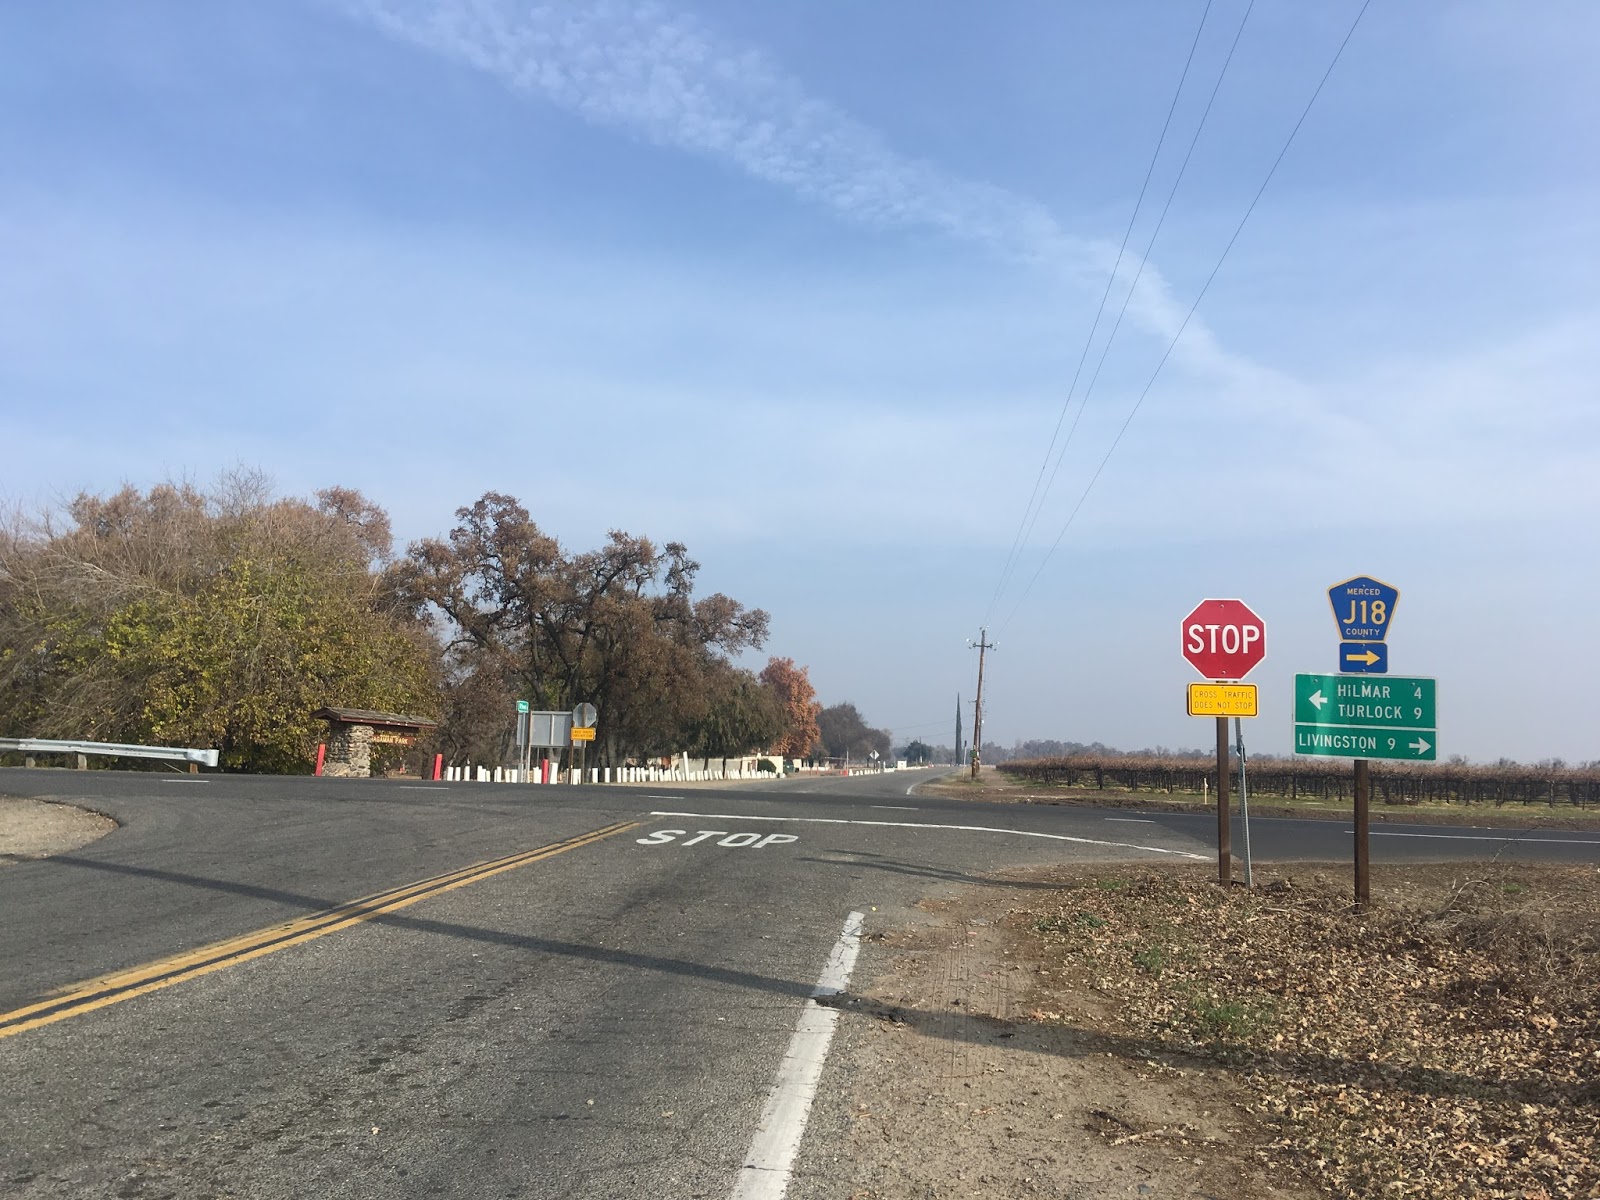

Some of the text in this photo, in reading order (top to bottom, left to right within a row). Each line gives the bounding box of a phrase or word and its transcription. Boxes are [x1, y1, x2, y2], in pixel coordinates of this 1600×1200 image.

[1346, 588, 1380, 596] MERCED
[1343, 600, 1386, 625] J18
[1187, 624, 1260, 654] STOP
[1346, 628, 1380, 636] COUNTY
[1194, 690, 1253, 699] CROSS TRAFFIC
[1413, 687, 1422, 699] 4
[1194, 701, 1213, 709] DOES
[1235, 702, 1253, 710] STOP
[1338, 704, 1422, 720] TURLOCK 9
[1299, 733, 1396, 750] LIVINGSTON 9
[635, 829, 799, 849] STOP
